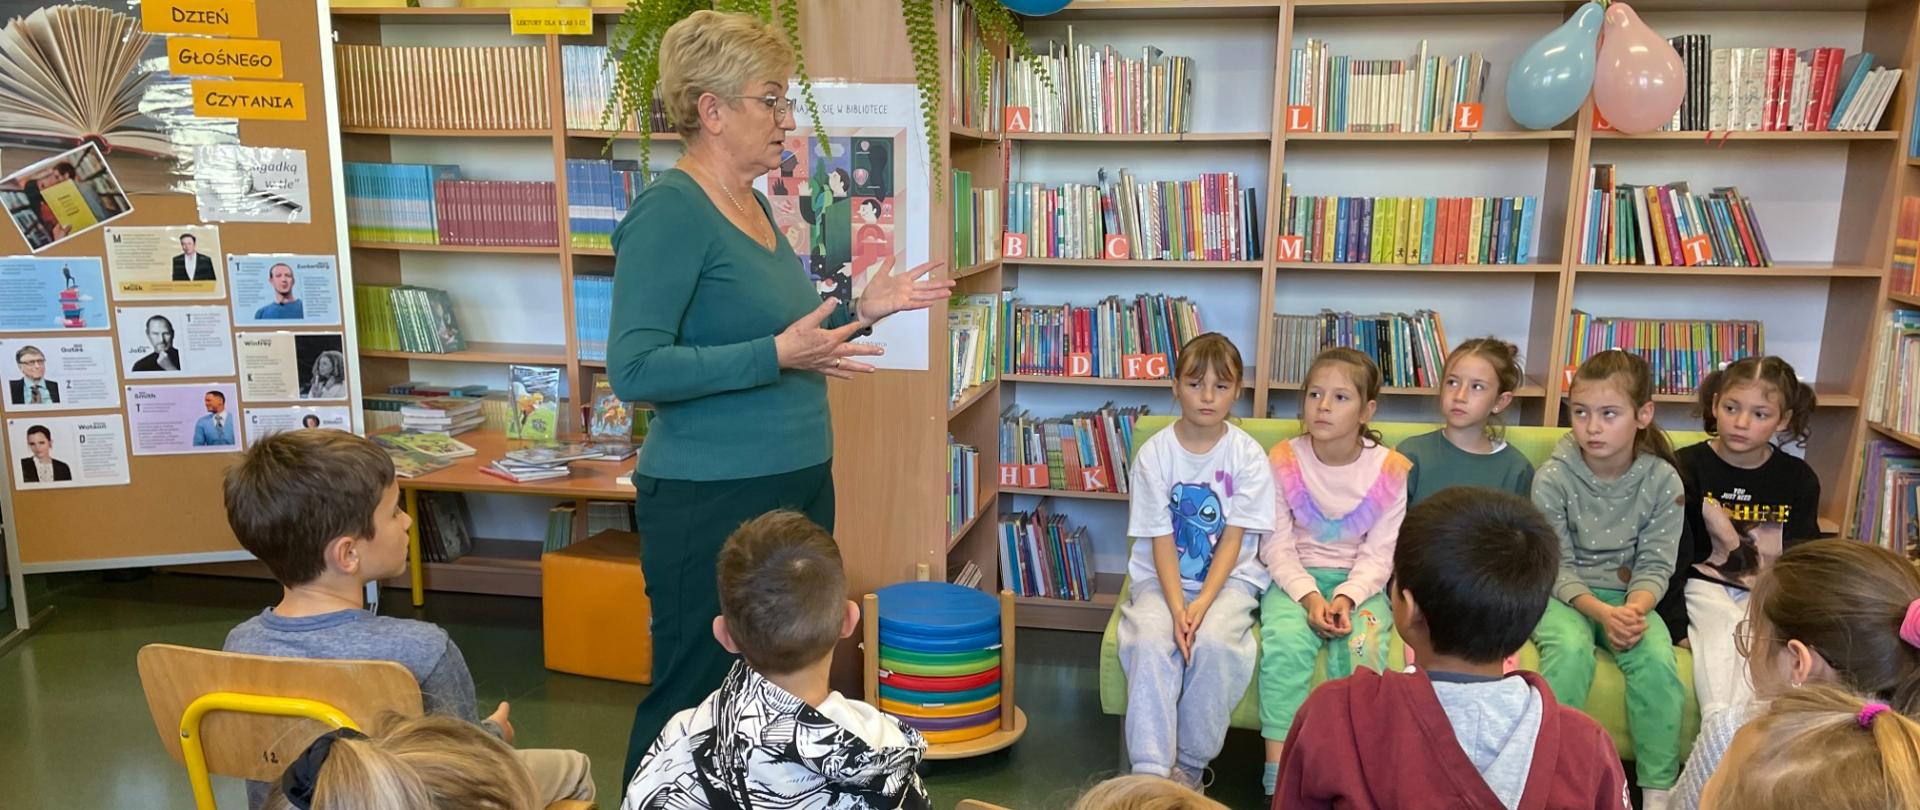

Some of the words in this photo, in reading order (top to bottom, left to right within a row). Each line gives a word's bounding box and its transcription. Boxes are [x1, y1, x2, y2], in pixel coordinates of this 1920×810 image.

[171, 6, 229, 25] DZIEŃ
[178, 48, 273, 67] GŁOŚNEGO
[205, 92, 294, 109] CZYTANIA
[822, 104, 834, 114] SIĘ
[837, 104, 843, 113] W
[846, 104, 888, 114] BIBLIOTECE
[1008, 111, 1026, 130] A
[1291, 109, 1310, 130] L
[1458, 107, 1479, 128] Ł
[113, 233, 122, 243] M
[1007, 237, 1023, 256] B
[1108, 238, 1127, 257] C
[1280, 240, 1302, 260] M
[1687, 239, 1707, 263] T
[1072, 356, 1090, 375] D
[1128, 358, 1142, 376] F
[1146, 357, 1166, 376] G
[136, 403, 141, 413] T
[1001, 466, 1018, 486] H
[1028, 467, 1037, 486] I
[1083, 470, 1104, 490] K
[1721, 492, 1737, 500] JUST
[263, 751, 279, 764] 12
